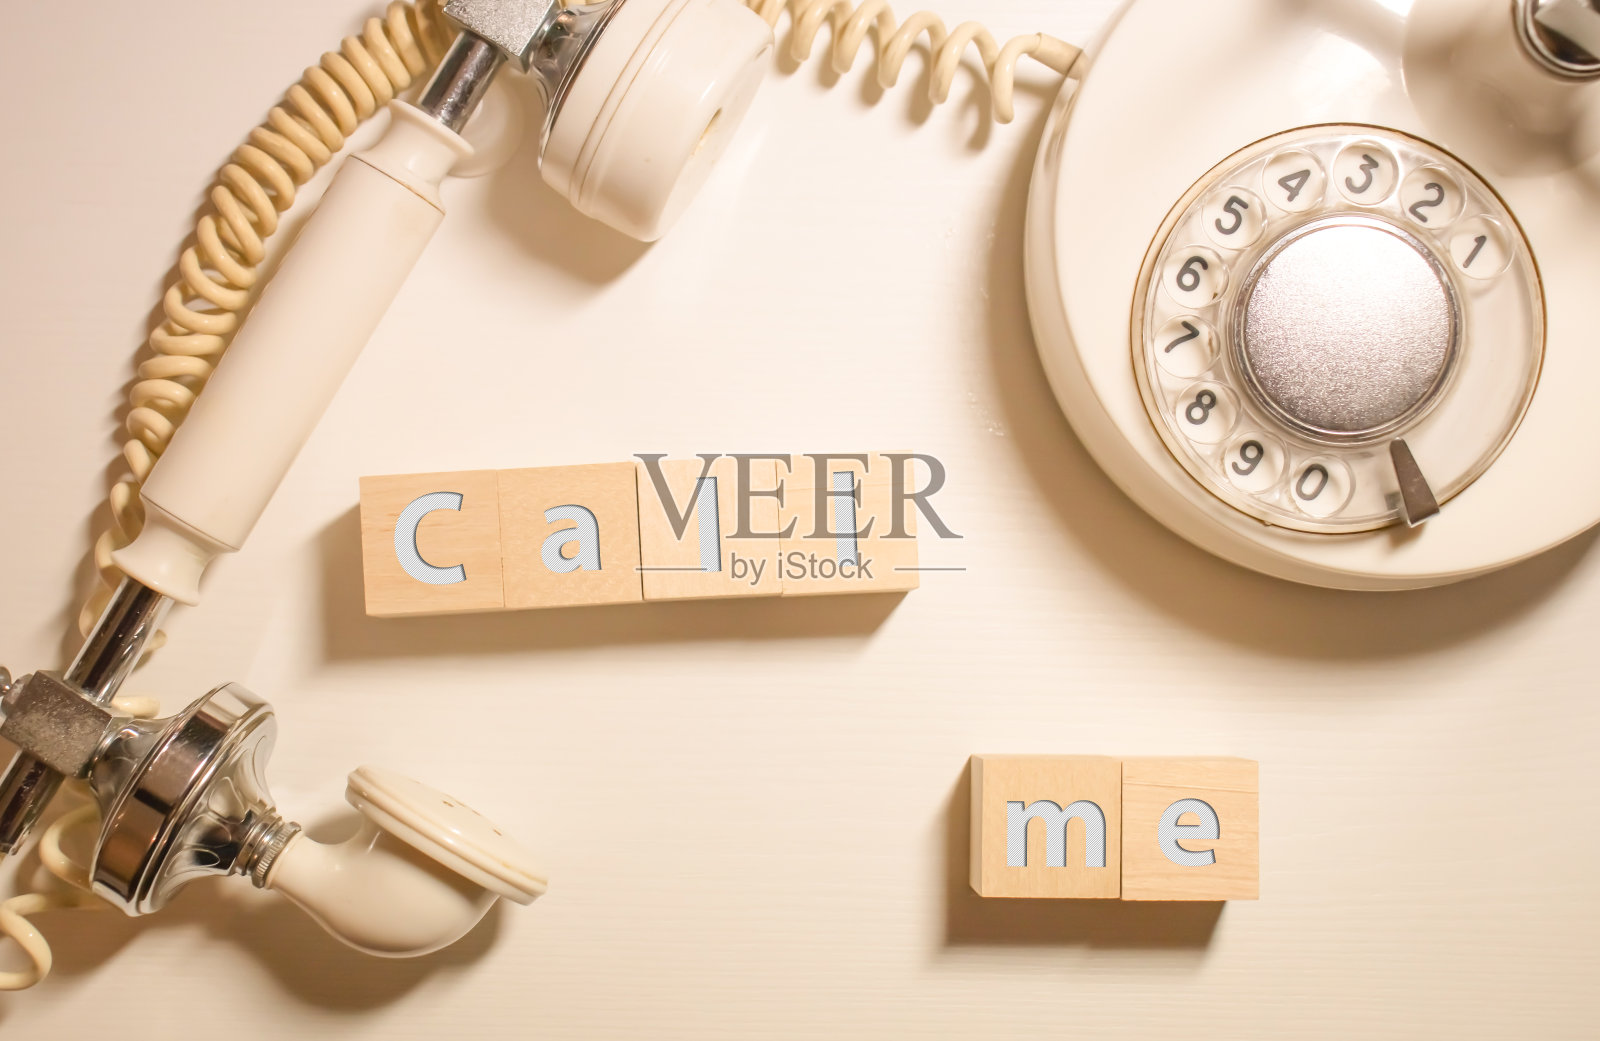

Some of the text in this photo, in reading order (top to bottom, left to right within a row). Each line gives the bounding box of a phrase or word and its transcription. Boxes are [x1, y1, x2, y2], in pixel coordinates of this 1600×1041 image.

[1278, 169, 1310, 202] 4
[1345, 154, 1379, 194] 3
[1215, 195, 1249, 235] 5
[1409, 182, 1445, 223] 2
[1463, 235, 1486, 268] 1
[1176, 256, 1208, 292] 6
[1165, 320, 1200, 353] 7
[1185, 389, 1216, 425] 8
[1232, 440, 1264, 476] 9
[1296, 464, 1328, 501] 0
[393, 471, 860, 585] Call
[1006, 798, 1221, 868] me
